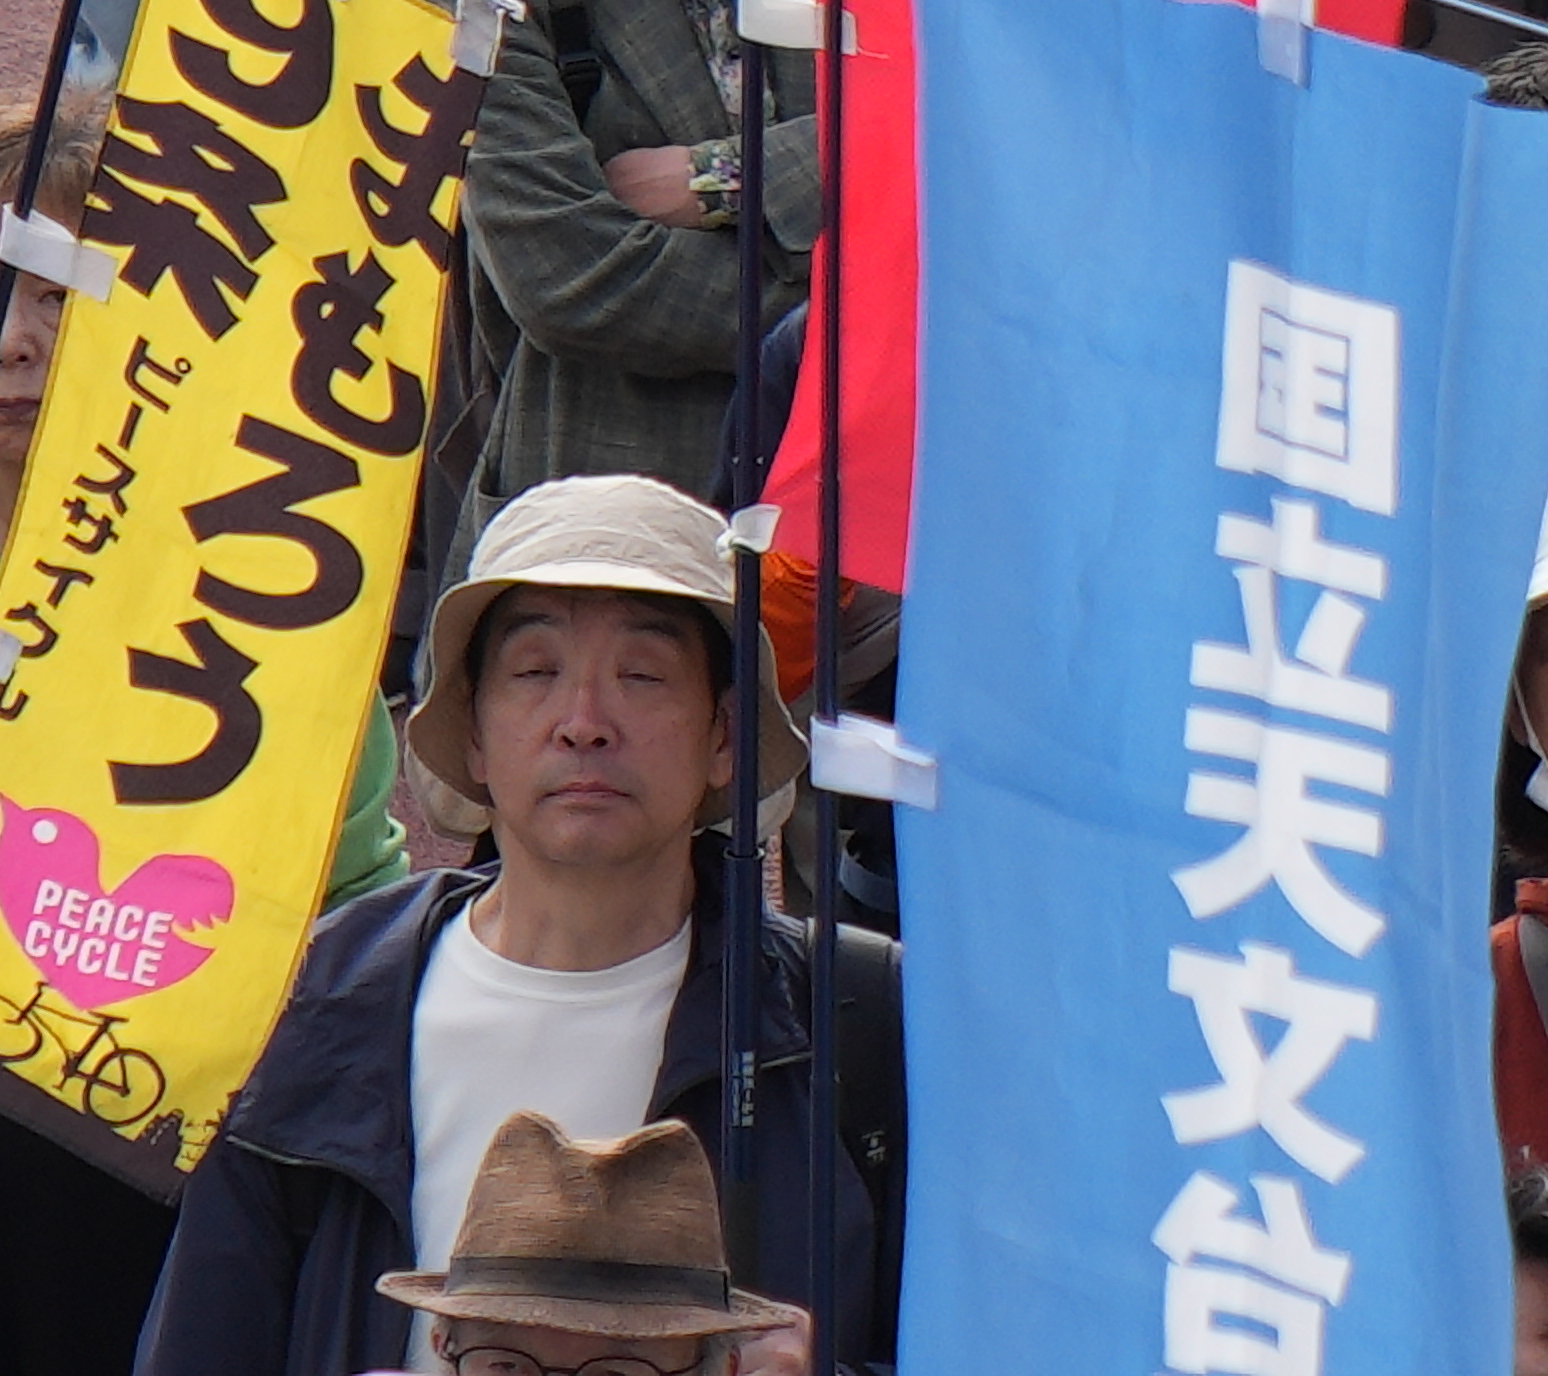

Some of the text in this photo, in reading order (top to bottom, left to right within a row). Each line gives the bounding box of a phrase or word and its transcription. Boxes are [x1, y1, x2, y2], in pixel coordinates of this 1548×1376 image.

[107, 52, 482, 807] まもろう
[33, 878, 174, 950] PEACE
[24, 919, 163, 988] CYCLE
